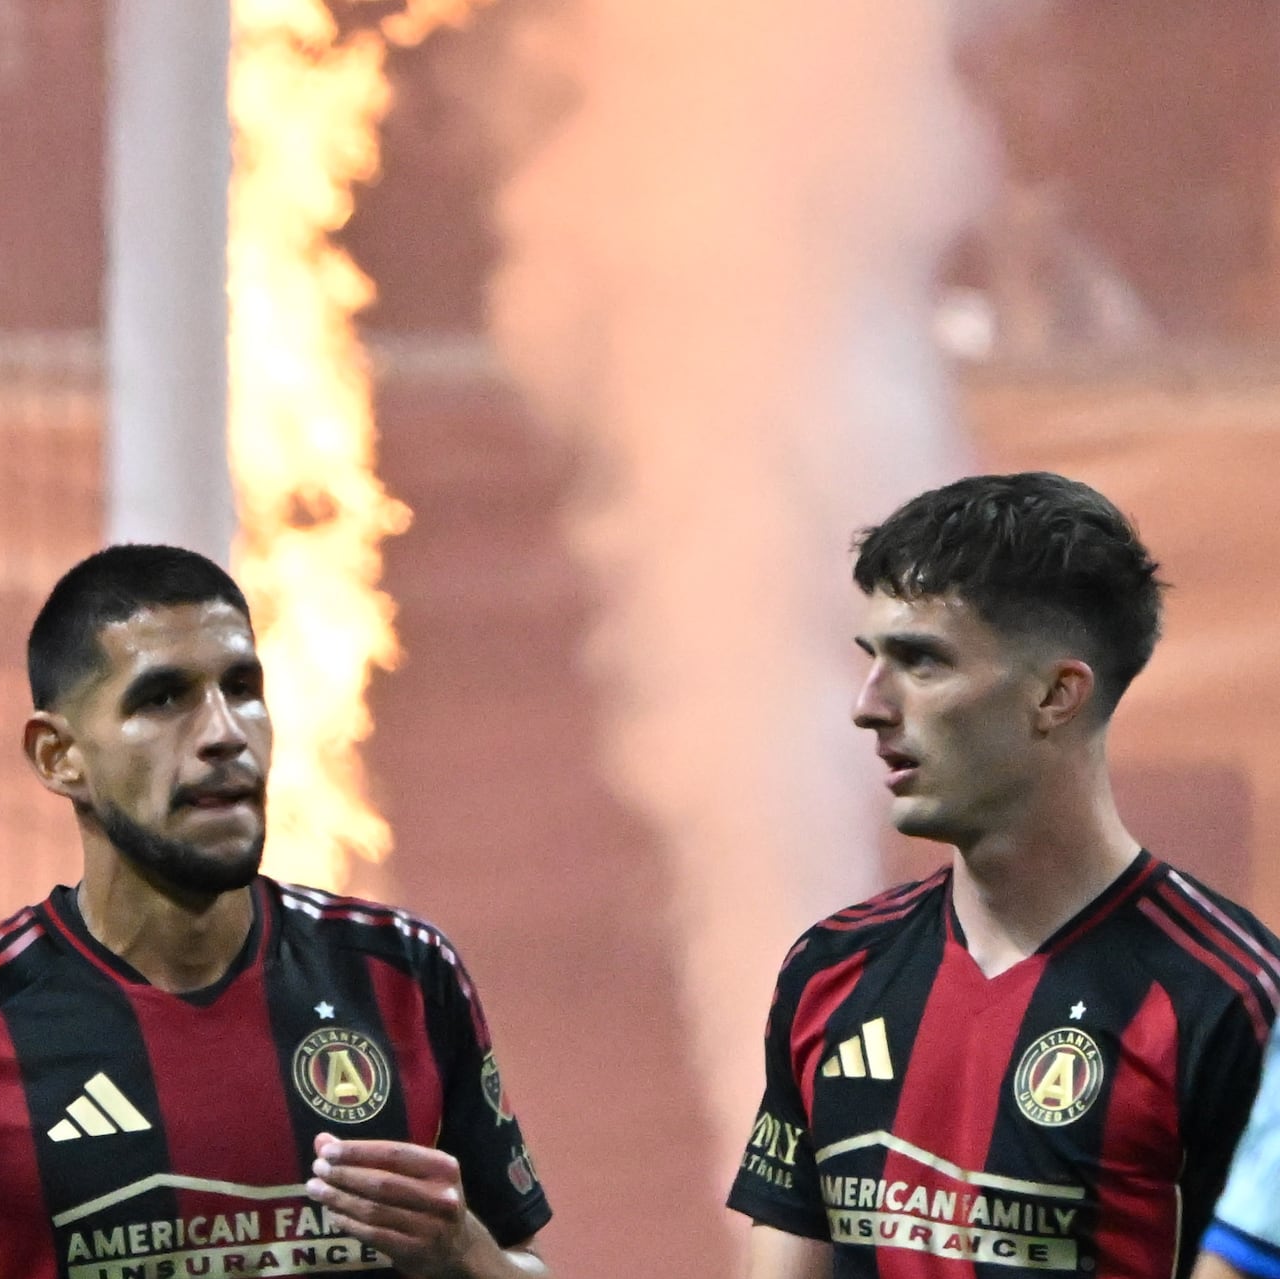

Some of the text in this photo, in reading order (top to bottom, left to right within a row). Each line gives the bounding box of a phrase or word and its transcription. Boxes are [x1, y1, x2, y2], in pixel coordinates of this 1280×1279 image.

[303, 1031, 368, 1055] ATLANTA
[1040, 1032, 1097, 1059] ATLANTA
[312, 1096, 366, 1119] UNITED
[1020, 1091, 1085, 1122] UNITED FC
[67, 1210, 261, 1263] AMERICAN
